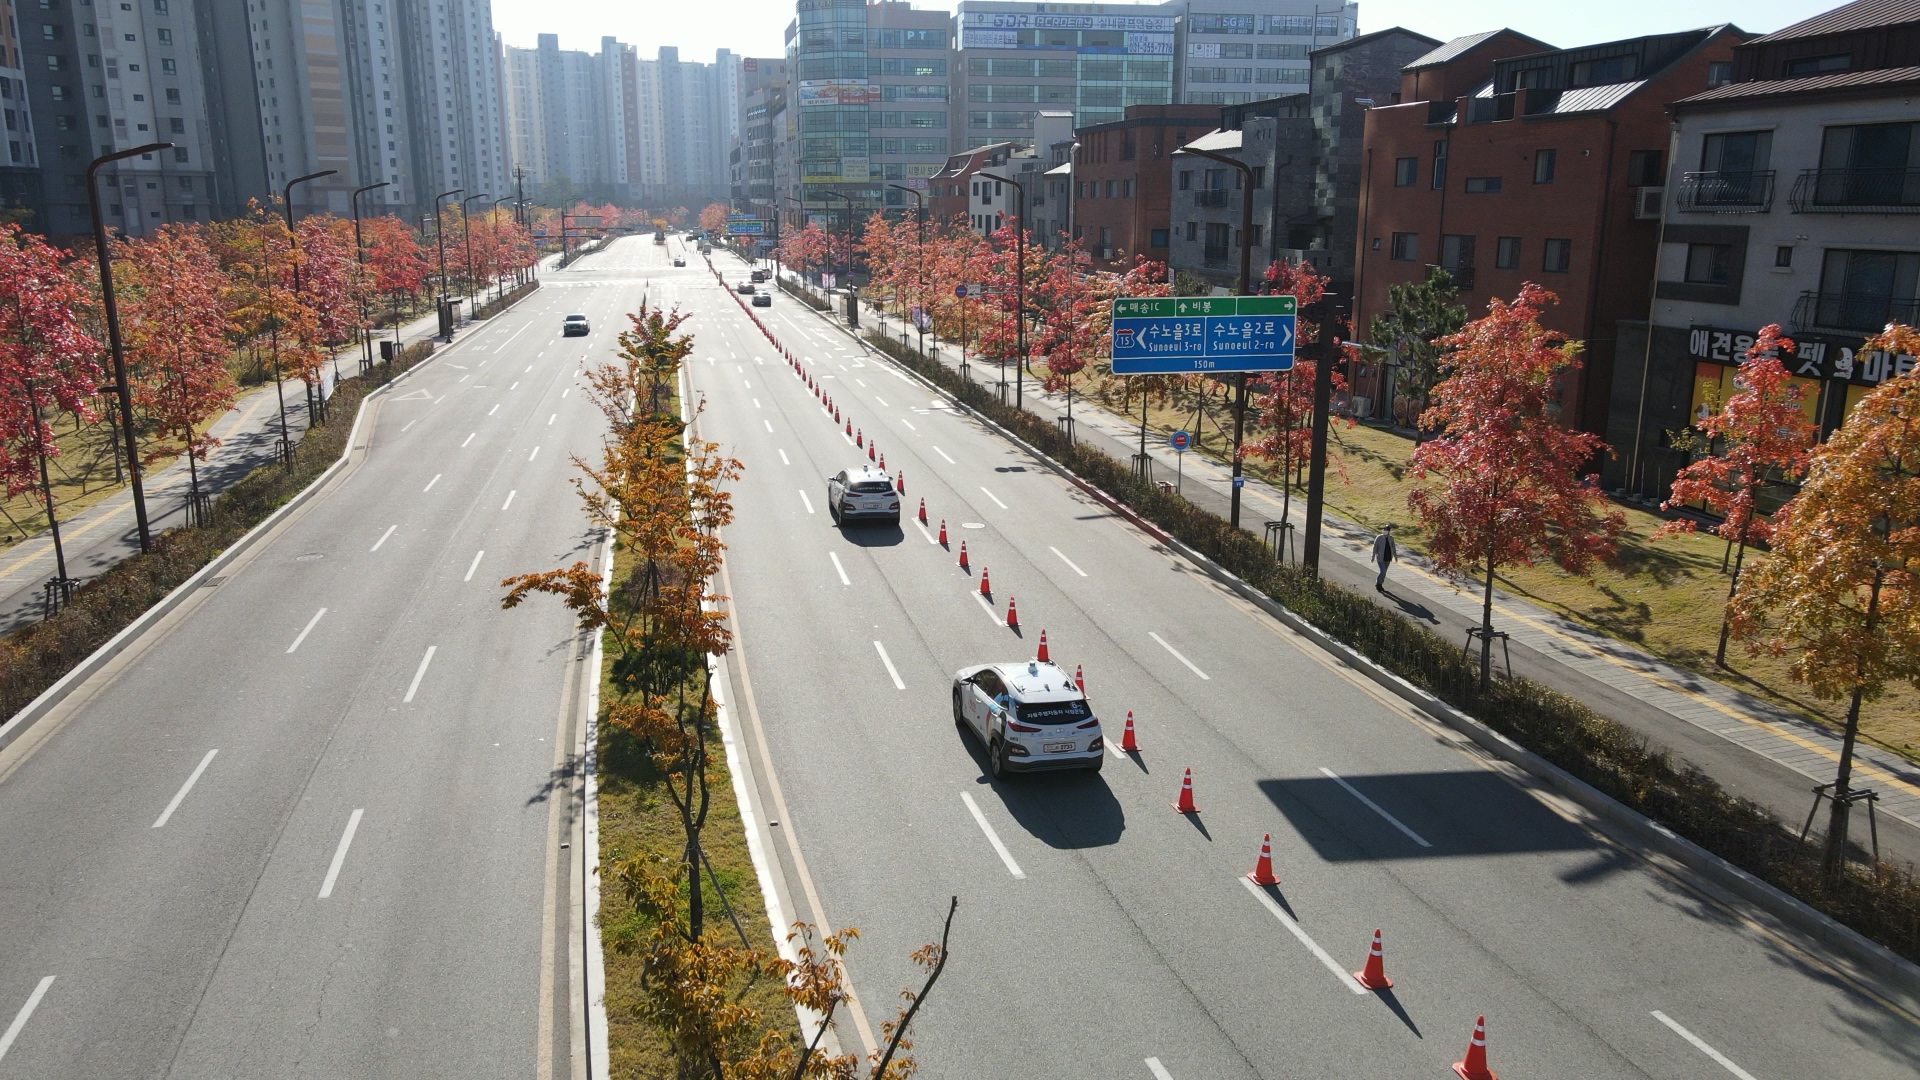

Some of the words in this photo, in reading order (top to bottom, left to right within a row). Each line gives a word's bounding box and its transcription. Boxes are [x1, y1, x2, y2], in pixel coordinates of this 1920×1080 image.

[1129, 301, 1160, 314] 매송IC
[1192, 301, 1212, 313] 비봉
[1149, 323, 1202, 341] 수노을3로
[1213, 321, 1275, 340] 수노을2로
[1120, 336, 1130, 346] 15
[1149, 342, 1182, 352] Sunoeul
[1184, 341, 1202, 351] 3-ro
[1213, 340, 1251, 351] Sunoeul
[1254, 340, 1275, 350] 2-ro
[1193, 359, 1215, 369] 150m
[1797, 341, 1826, 376] 펫
